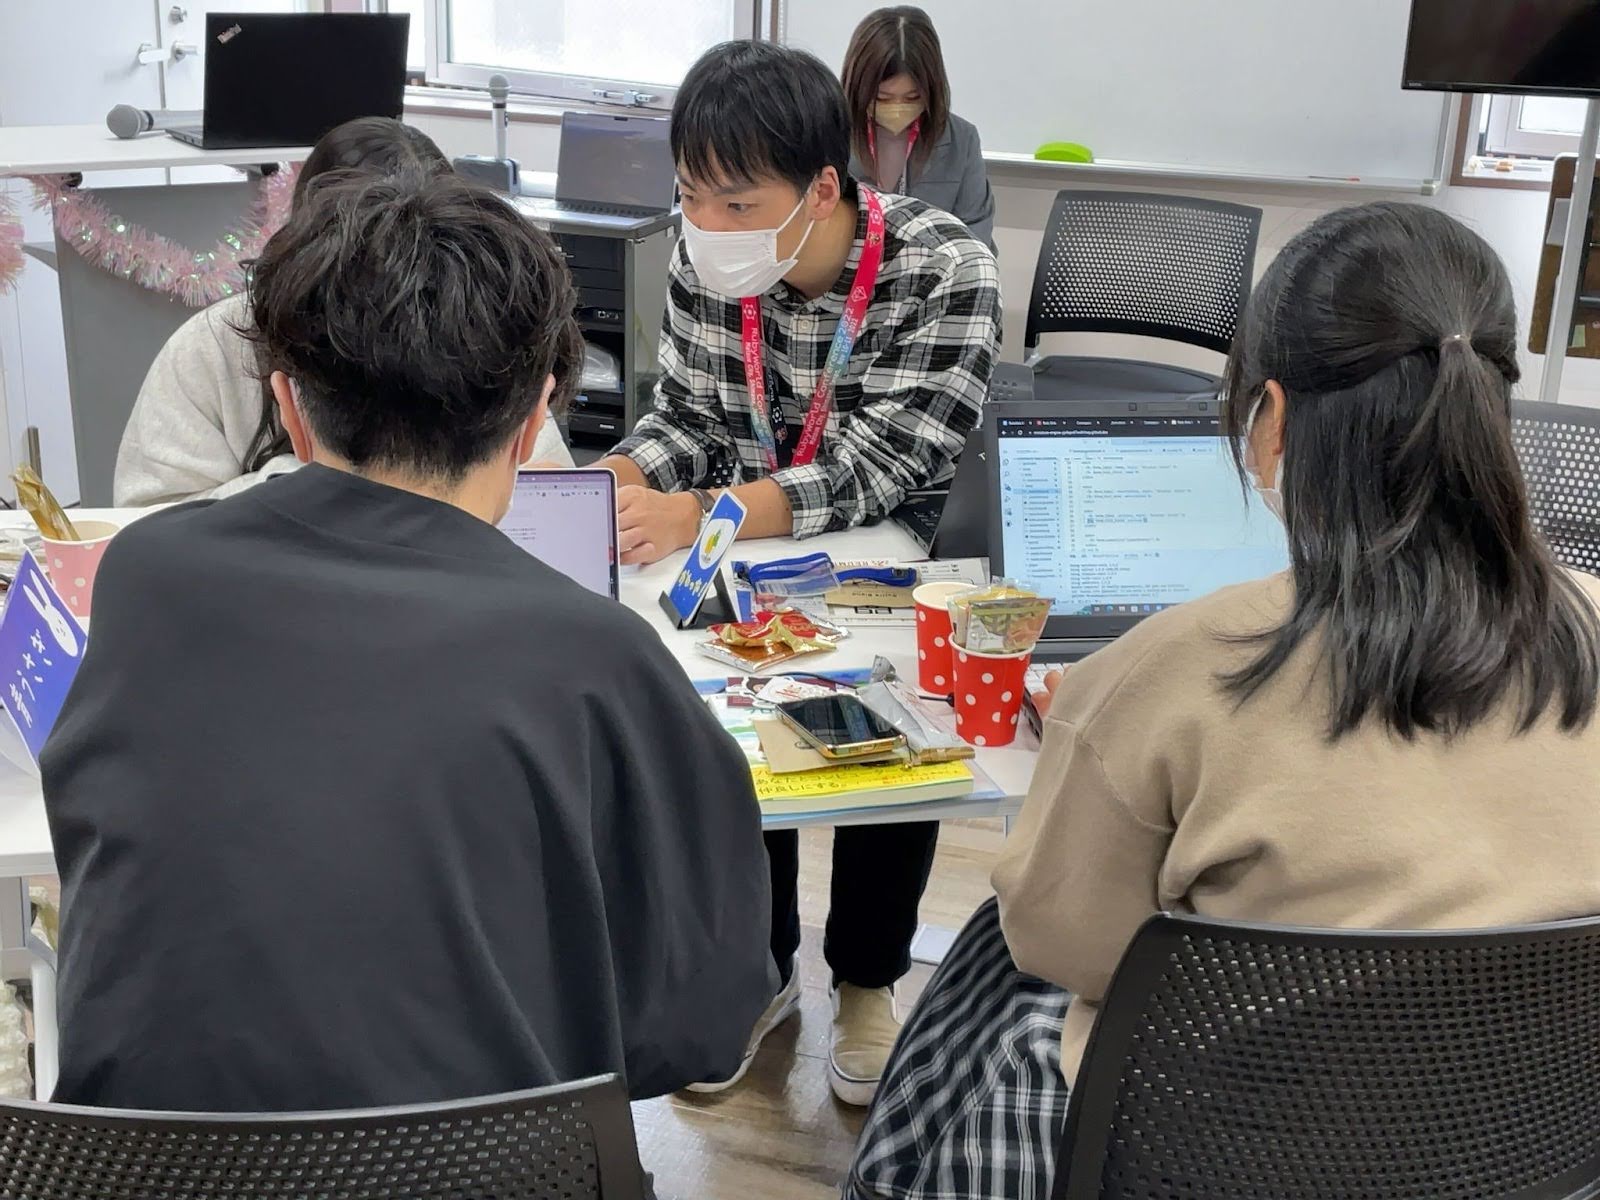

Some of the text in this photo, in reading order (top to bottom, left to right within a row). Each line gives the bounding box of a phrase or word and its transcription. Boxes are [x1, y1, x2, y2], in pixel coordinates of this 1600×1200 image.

[816, 335, 844, 399] Conference
[839, 307, 855, 335] 2022
[9, 628, 53, 728] 青うさぎ
